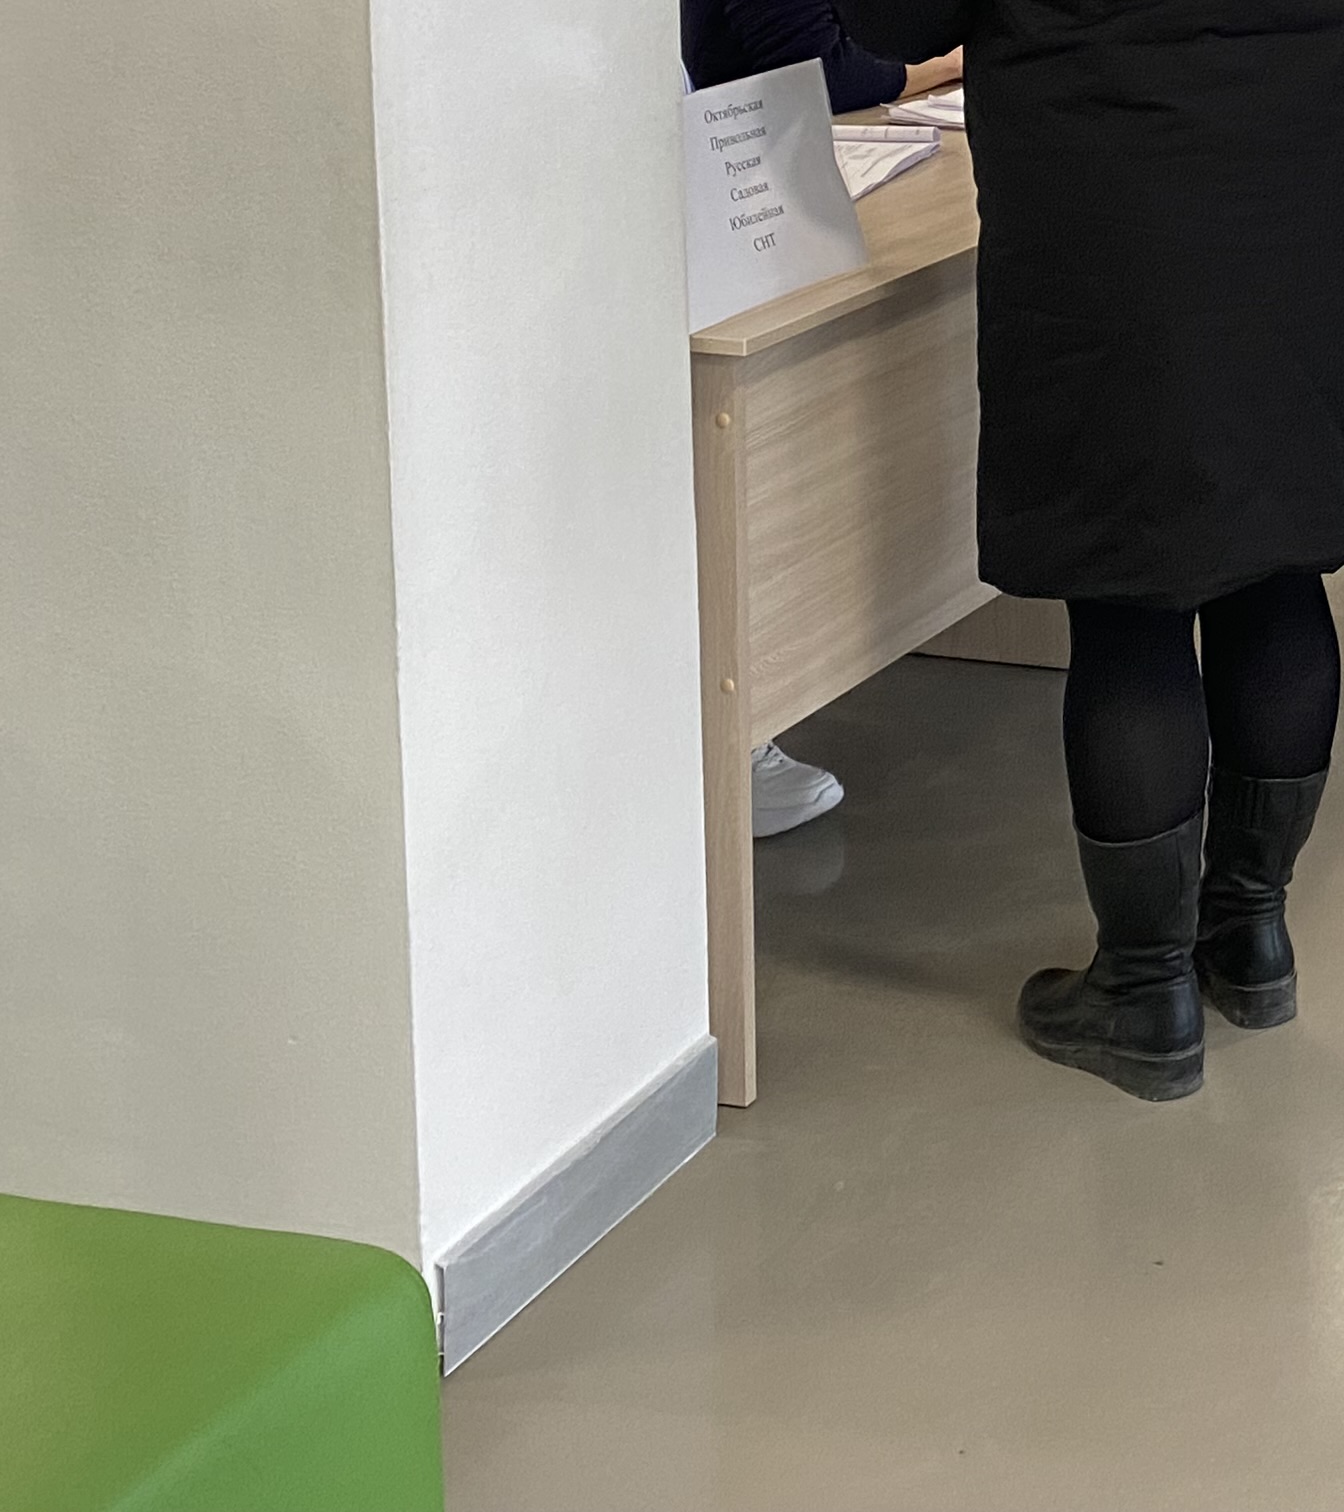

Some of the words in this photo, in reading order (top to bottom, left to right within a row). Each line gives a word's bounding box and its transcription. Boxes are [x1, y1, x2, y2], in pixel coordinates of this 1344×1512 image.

[704, 100, 763, 124] Октябрьская
[725, 156, 761, 177] Русская
[730, 182, 769, 202] Садовая
[729, 205, 784, 231] Юбилейная
[753, 233, 776, 252] СНТ
